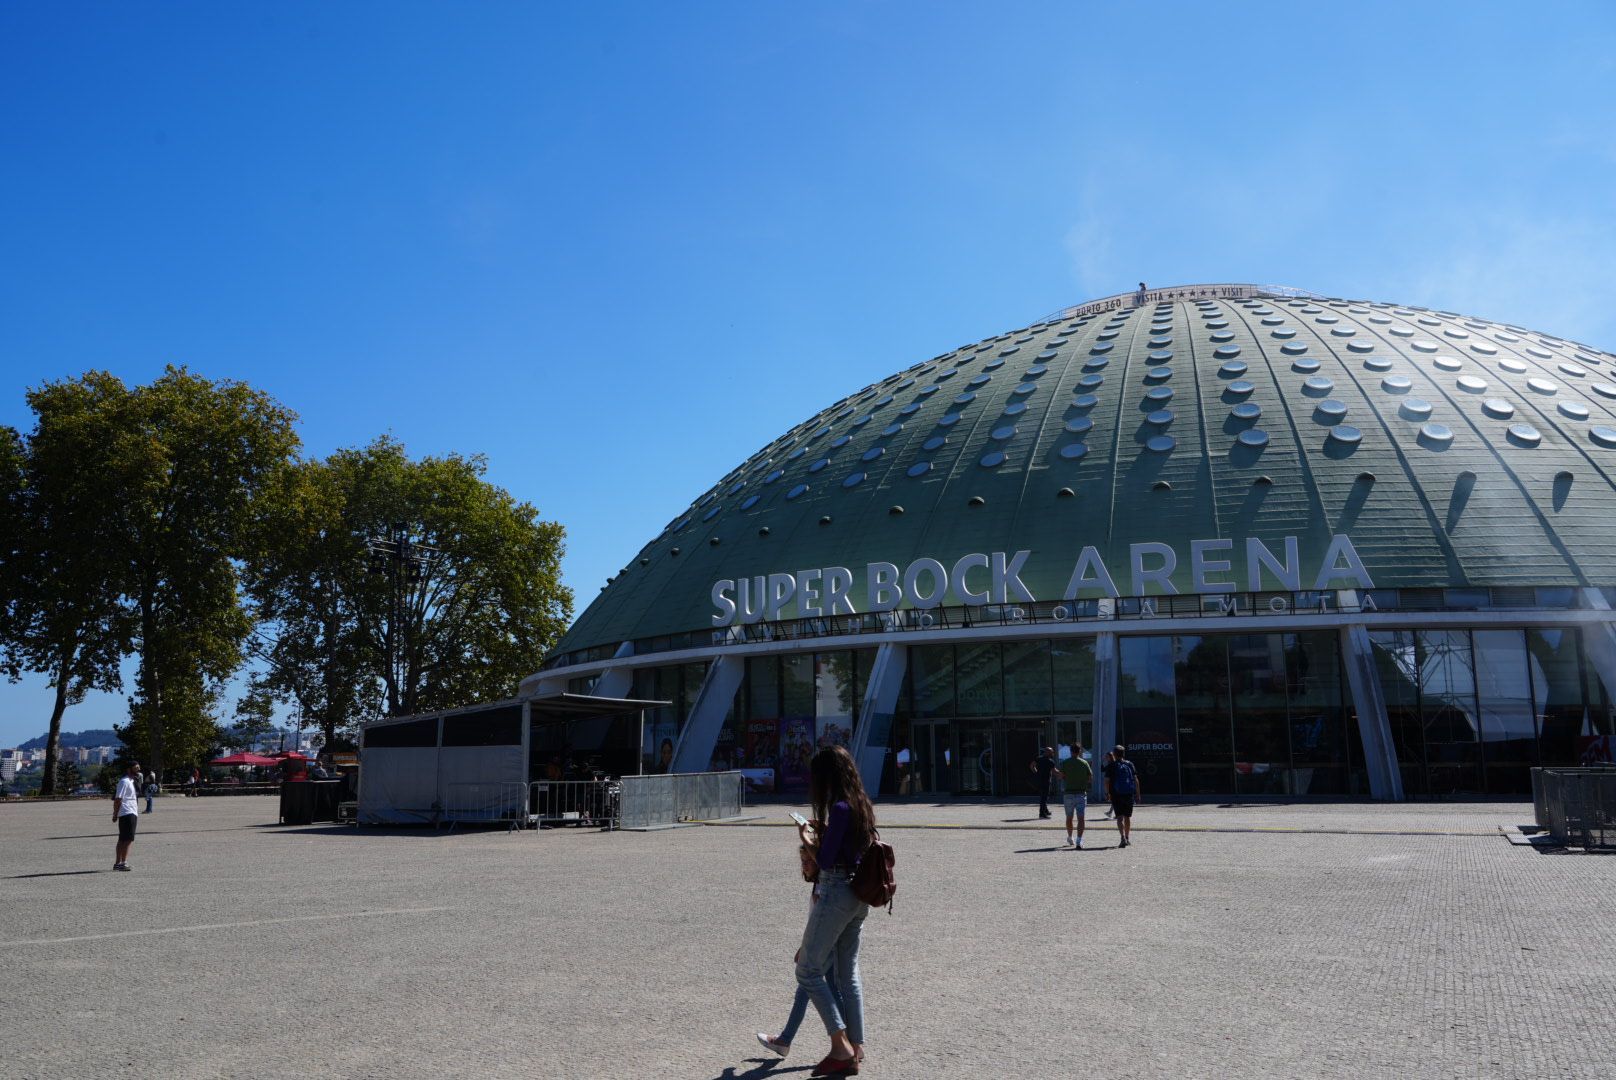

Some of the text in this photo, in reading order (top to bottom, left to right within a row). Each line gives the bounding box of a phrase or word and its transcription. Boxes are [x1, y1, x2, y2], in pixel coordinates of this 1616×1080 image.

[1135, 292, 1164, 304] VISITA
[1221, 287, 1244, 297] VISIT
[1076, 299, 1122, 317] PORTO 360
[711, 534, 1376, 627] SUPER BOCK ARENA
[1012, 600, 1156, 624] ROSA
[1220, 595, 1378, 616] MOTA
[1128, 743, 1174, 751] SUPER BOCK
